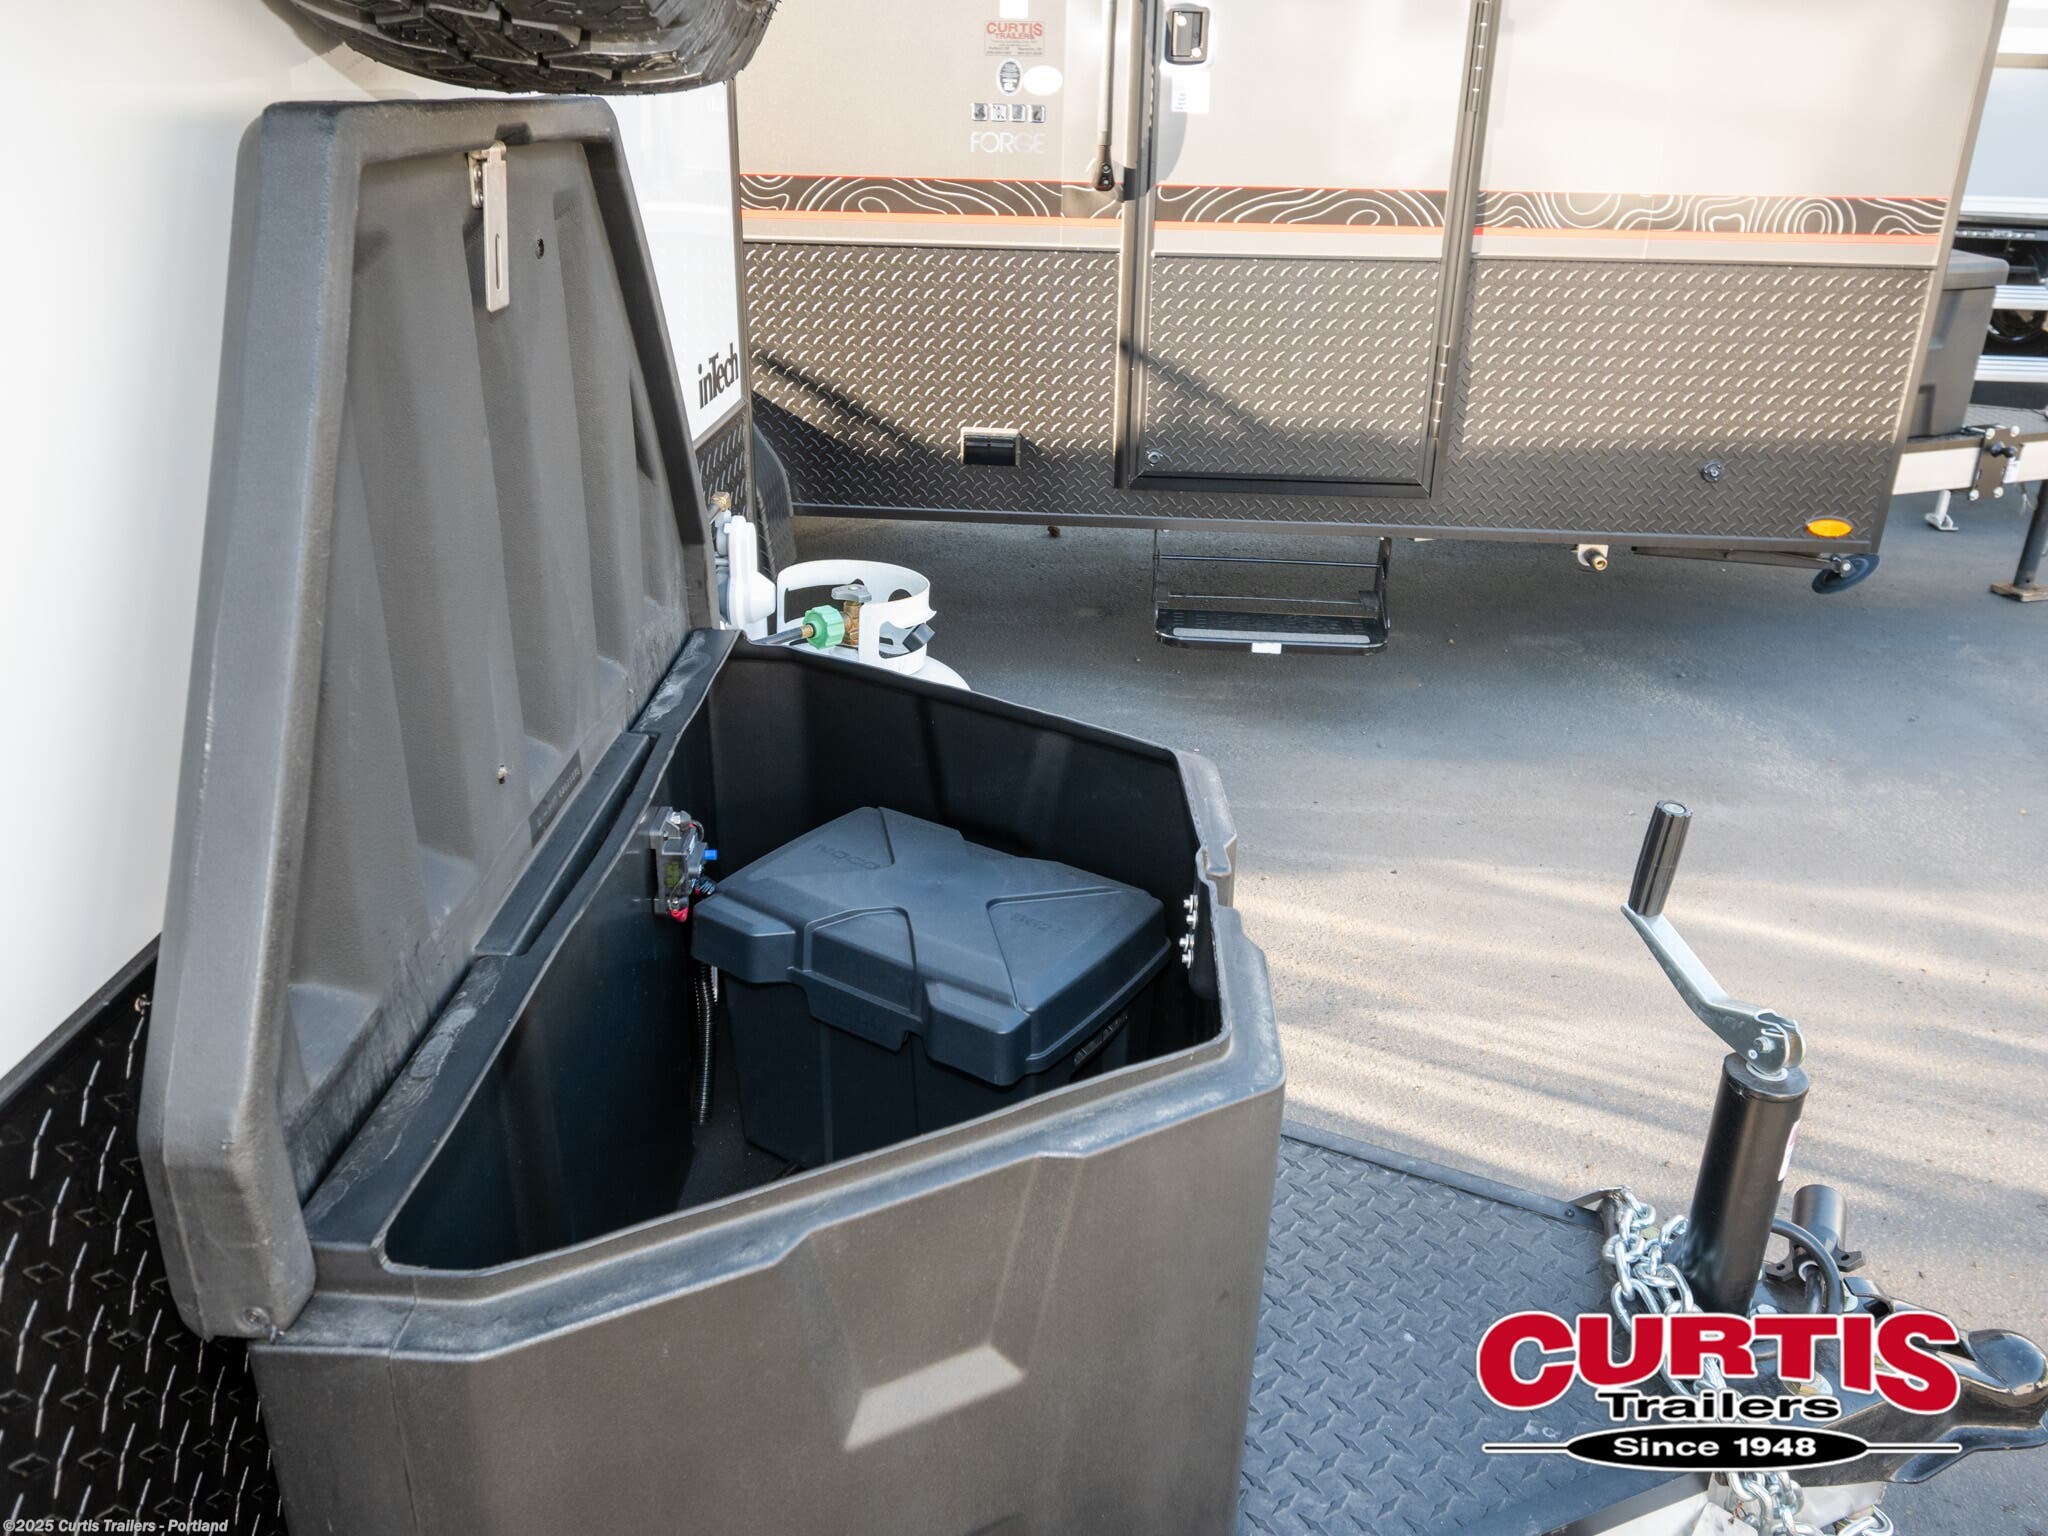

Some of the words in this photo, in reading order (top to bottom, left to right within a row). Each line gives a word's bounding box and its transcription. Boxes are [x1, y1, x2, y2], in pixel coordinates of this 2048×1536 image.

[986, 22, 1043, 36] CURTIS
[970, 131, 1047, 153] FORGE
[698, 342, 739, 409] inTech
